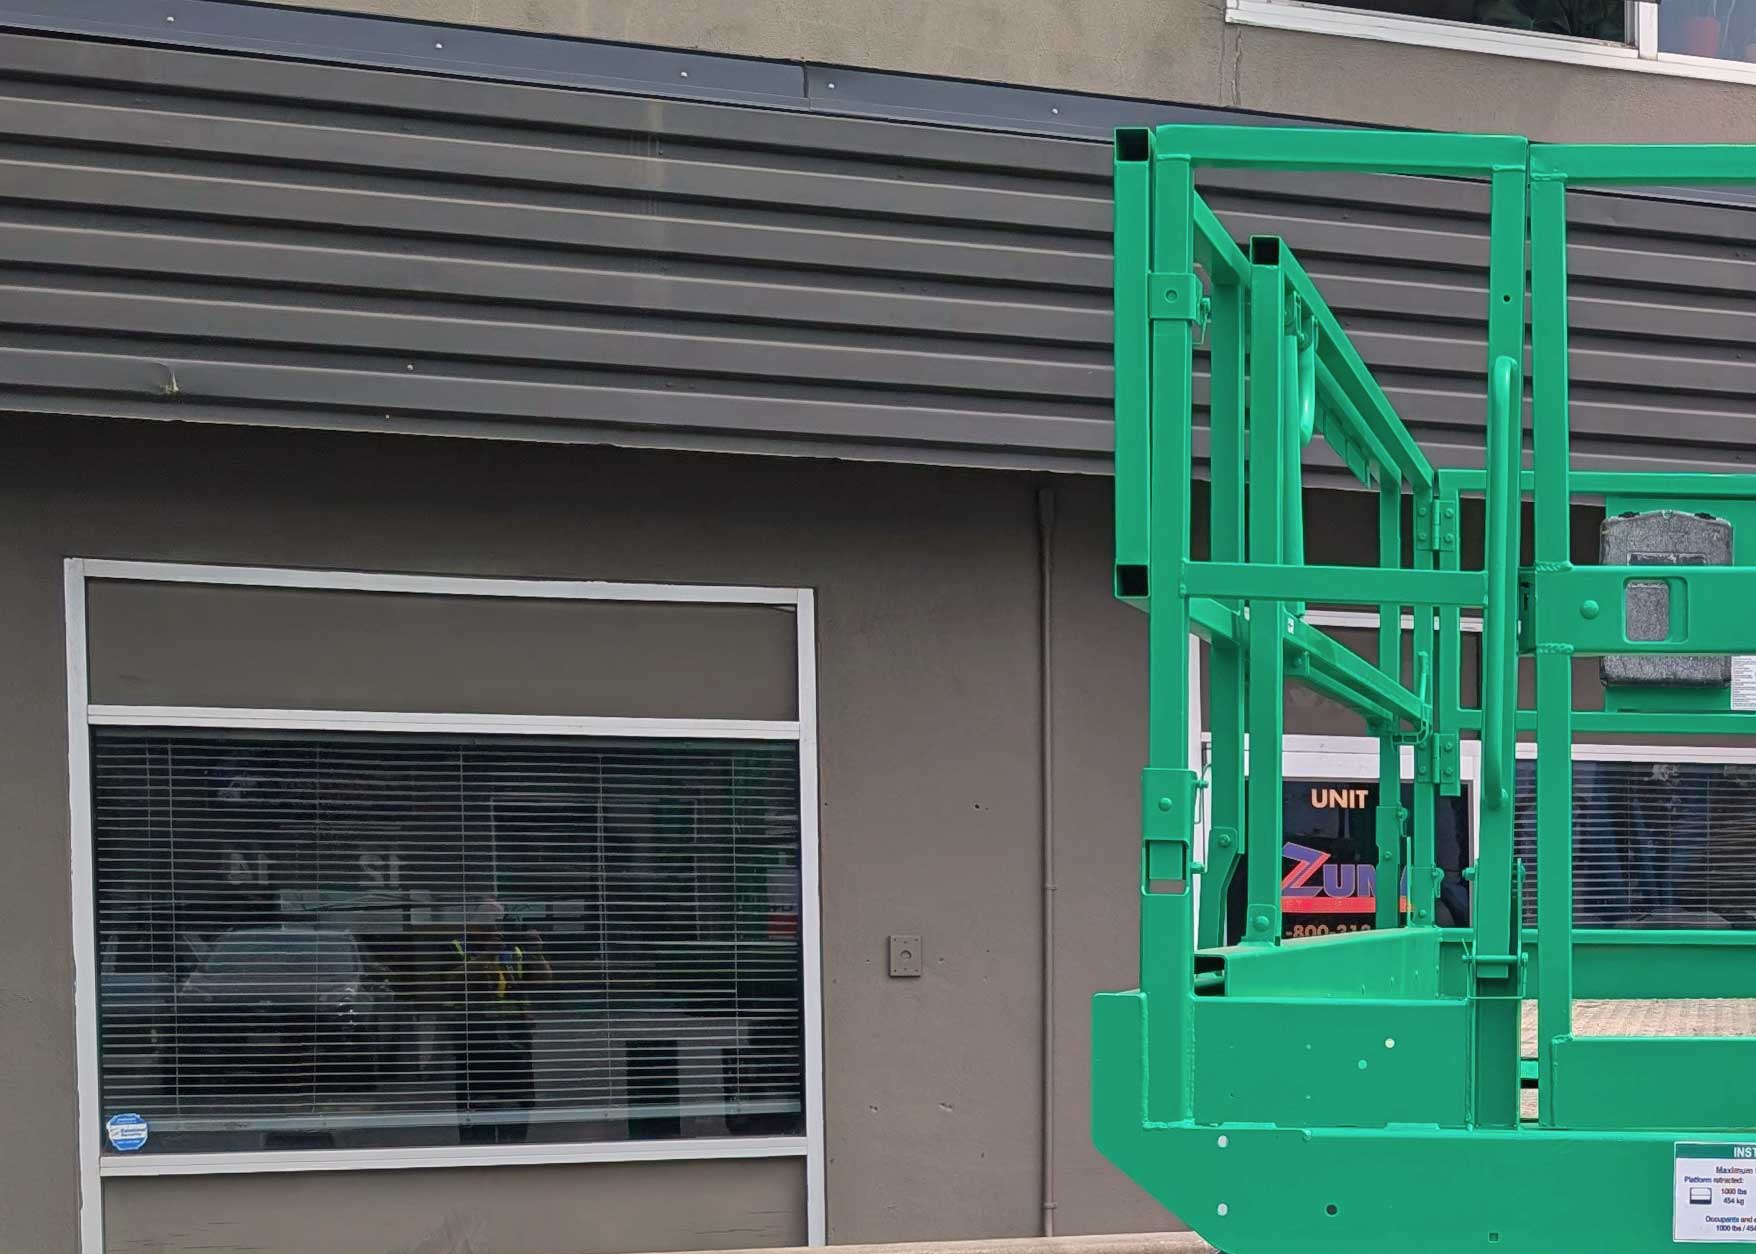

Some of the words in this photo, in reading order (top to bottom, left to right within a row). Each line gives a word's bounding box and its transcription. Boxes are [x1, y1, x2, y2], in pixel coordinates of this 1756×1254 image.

[1311, 788, 1369, 809] UNIT
[1716, 1166, 1753, 1175] Maximum
[1736, 1198, 1744, 1206] kg
[1705, 1215, 1739, 1224] Occupants
